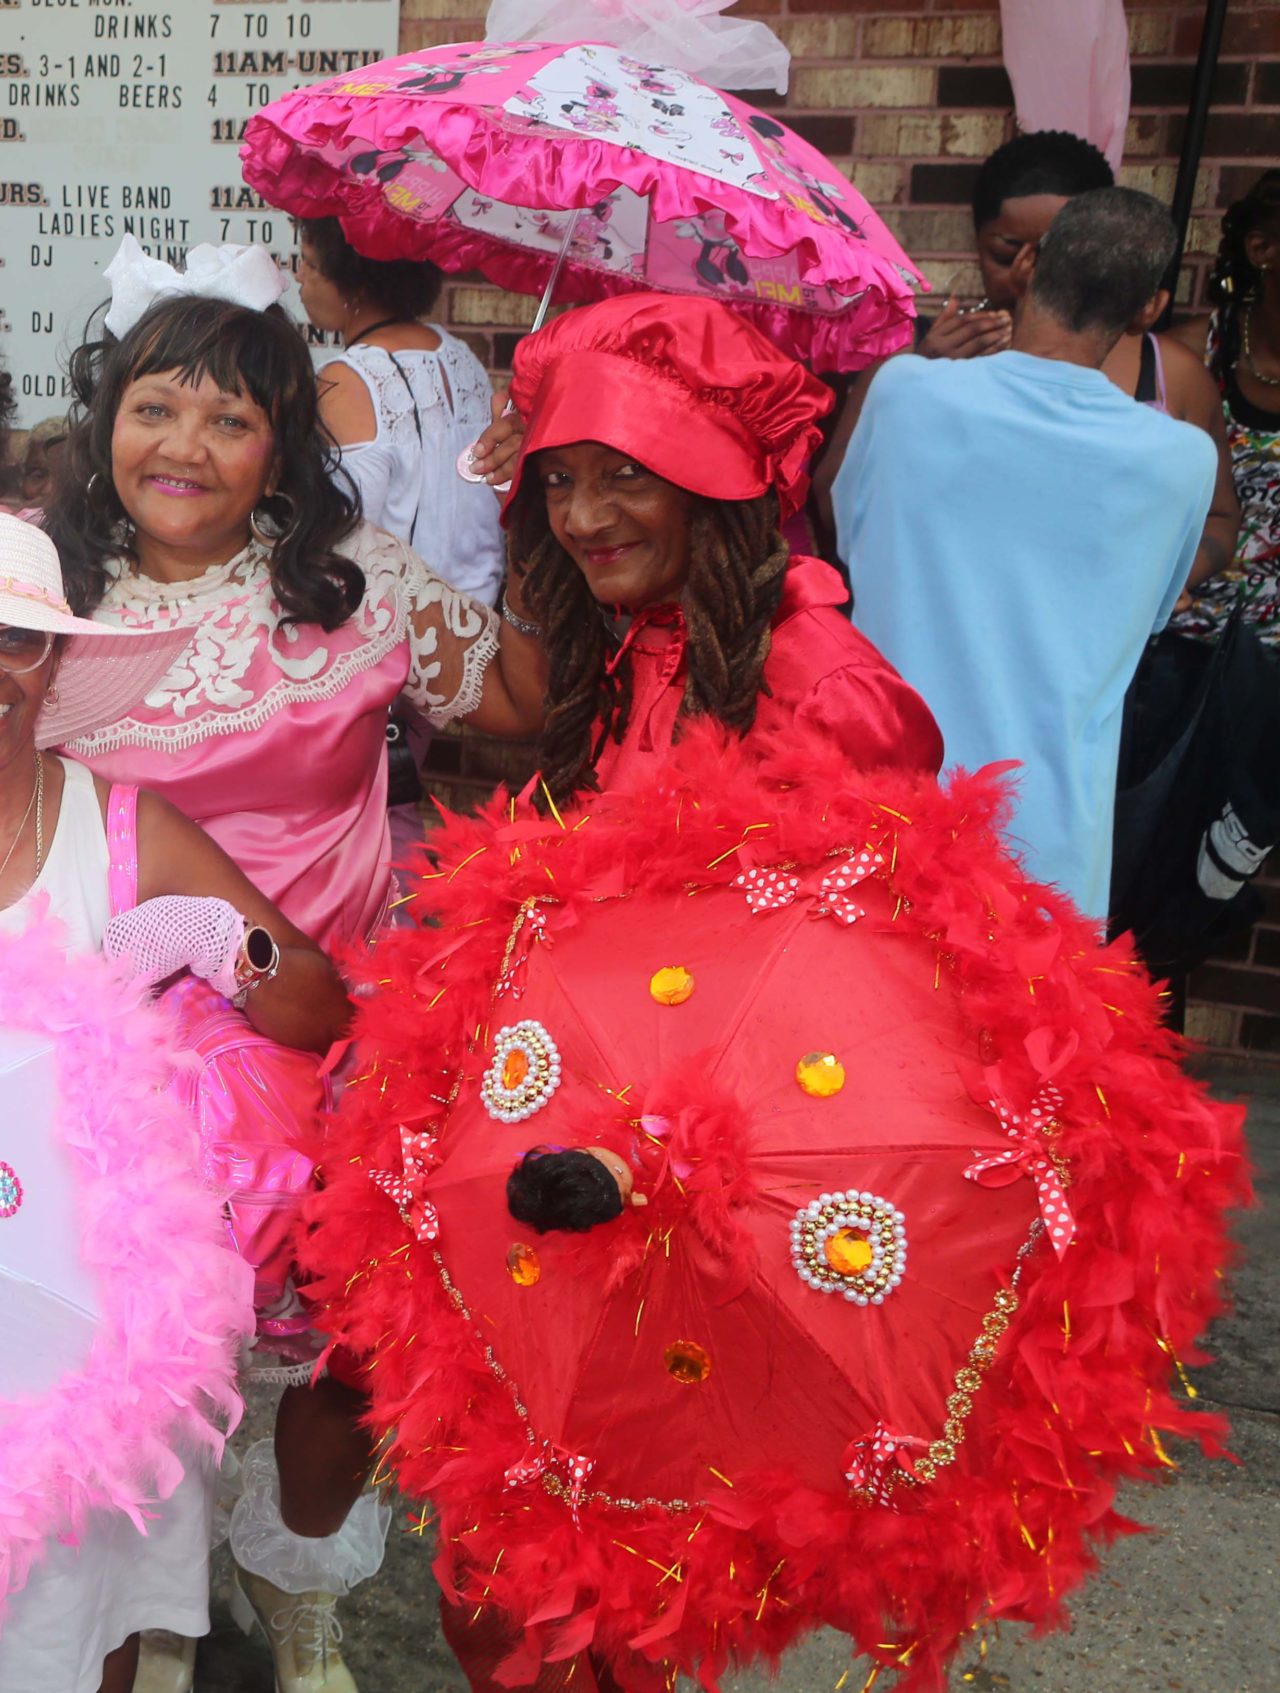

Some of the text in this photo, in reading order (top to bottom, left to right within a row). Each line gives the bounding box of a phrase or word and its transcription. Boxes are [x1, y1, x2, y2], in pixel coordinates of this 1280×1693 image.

[94, 14, 311, 38] DRINKS 7 TO 10
[39, 54, 75, 78] 3-1
[84, 54, 120, 77] AND
[133, 54, 166, 77] 2-1
[9, 84, 269, 109] DRINKS BEERS 4 TO
[63, 185, 109, 208] LIVE
[123, 186, 171, 209] BAND
[39, 212, 115, 237] LADIES
[124, 216, 190, 242] NIGHT
[220, 219, 230, 242] 7
[247, 220, 272, 243] TO
[31, 245, 53, 267] DJ
[32, 311, 53, 333] DJ
